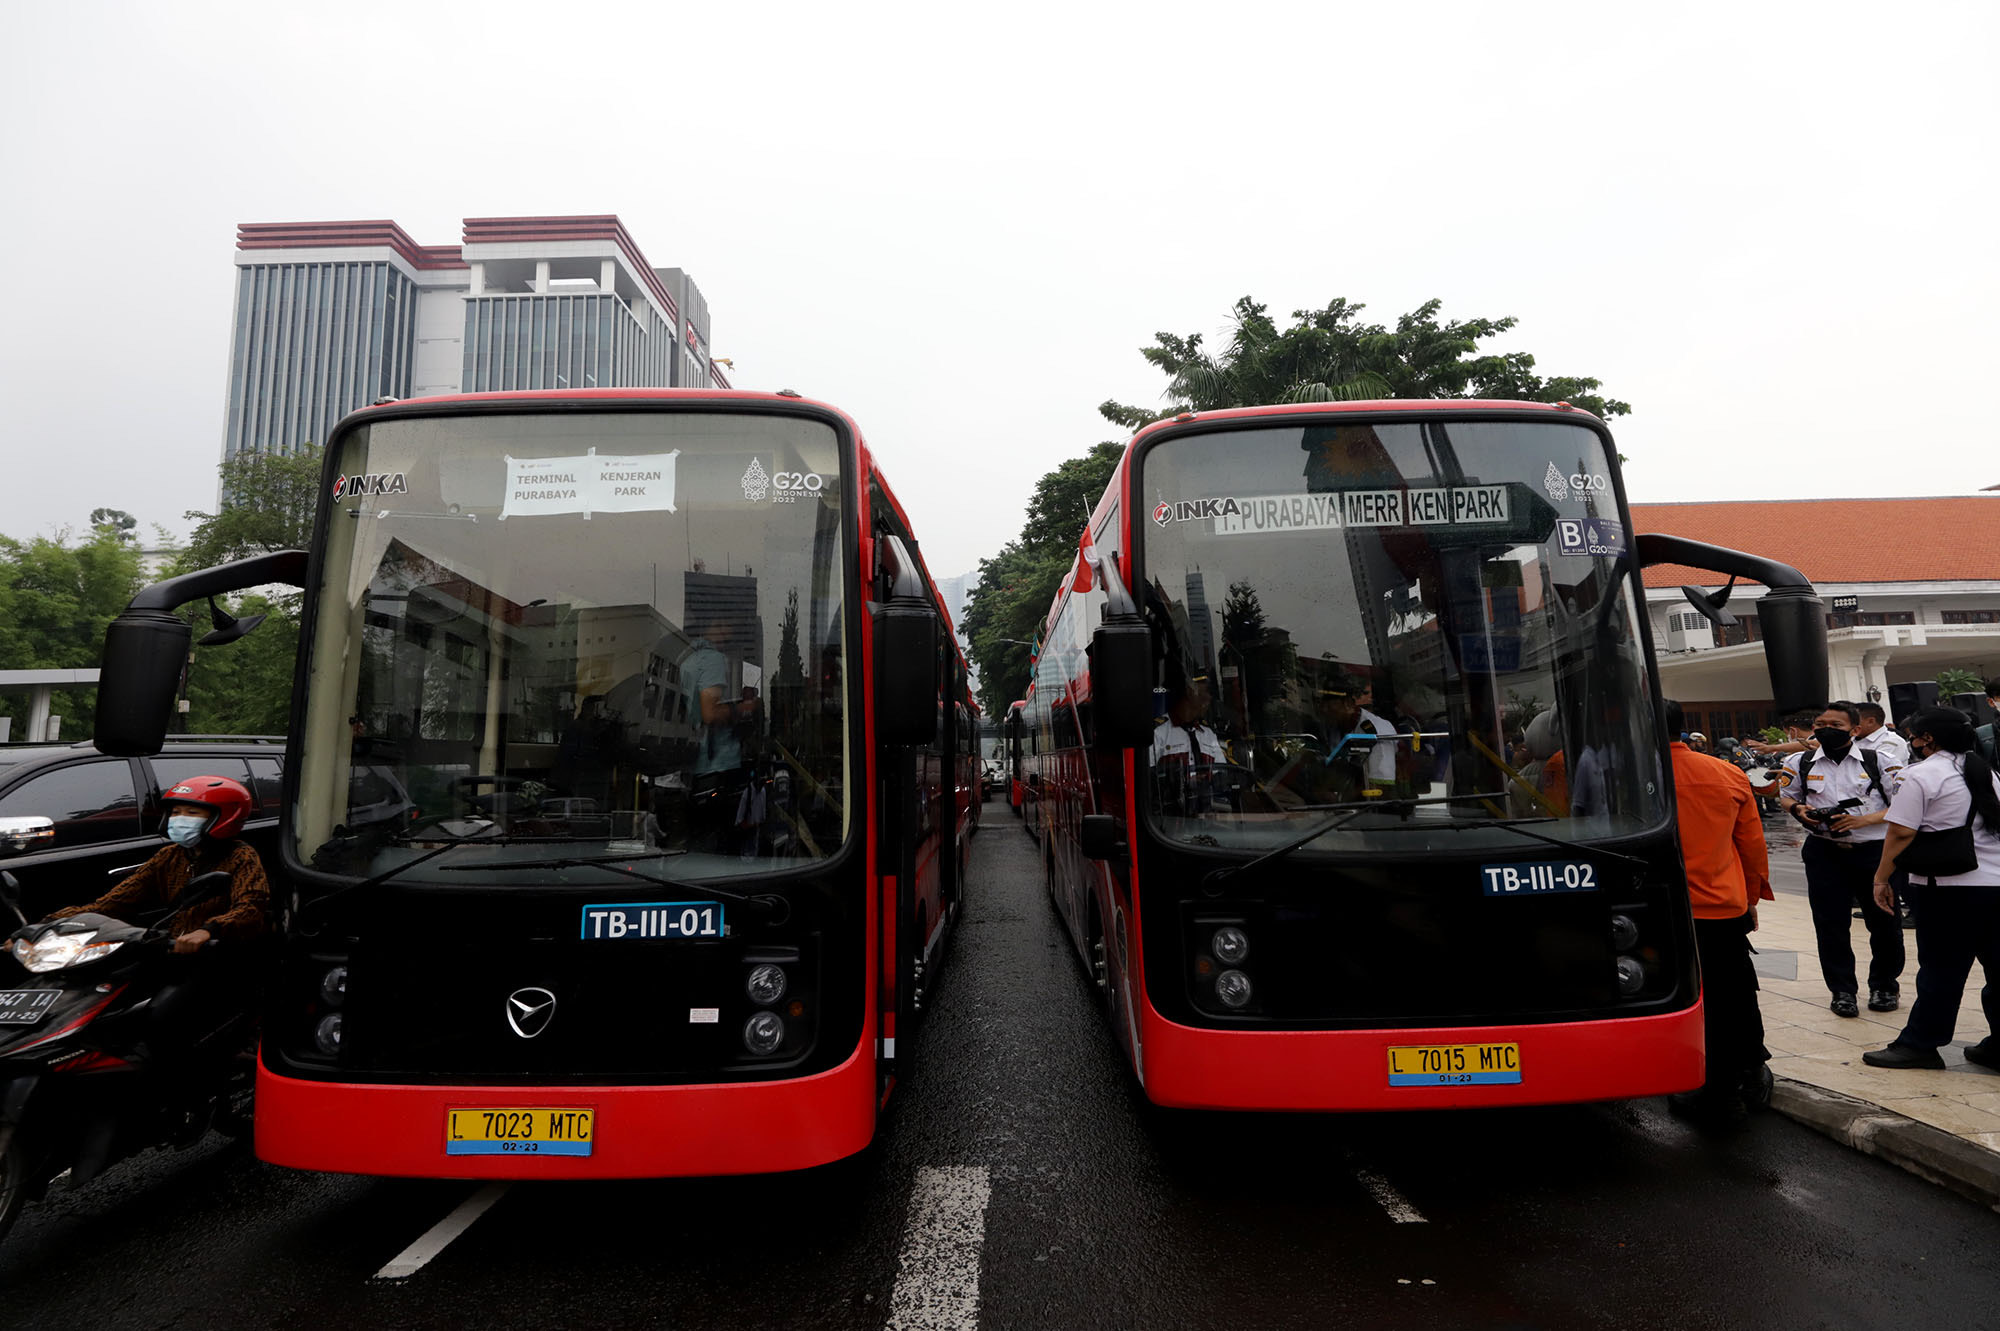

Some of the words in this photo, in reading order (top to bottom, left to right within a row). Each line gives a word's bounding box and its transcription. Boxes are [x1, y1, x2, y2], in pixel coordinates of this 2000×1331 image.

[347, 473, 408, 496] INKA
[517, 474, 577, 485] TERMINAL
[600, 471, 661, 481] KENJERAN
[773, 472, 823, 491] G20
[1569, 473, 1606, 490] G20
[514, 490, 577, 500] PURABAYA
[614, 487, 646, 496] PARK
[773, 490, 823, 498] INDONESIA
[1175, 497, 1241, 521] INKA
[1241, 496, 1340, 530] PURABAYA
[1350, 494, 1400, 523] MERR
[1411, 492, 1447, 521] KEN
[1454, 489, 1504, 519] PARK
[1561, 522, 1581, 546] B
[1589, 545, 1608, 554] G20
[1484, 863, 1595, 892] TB-III-02
[589, 908, 717, 939] TB-III-01
[1392, 1051, 1403, 1073] L
[1418, 1047, 1465, 1072] 7015
[1479, 1046, 1516, 1070] MTC
[453, 1113, 463, 1139] L
[483, 1112, 533, 1138] 7023
[549, 1113, 589, 1139] MTC
